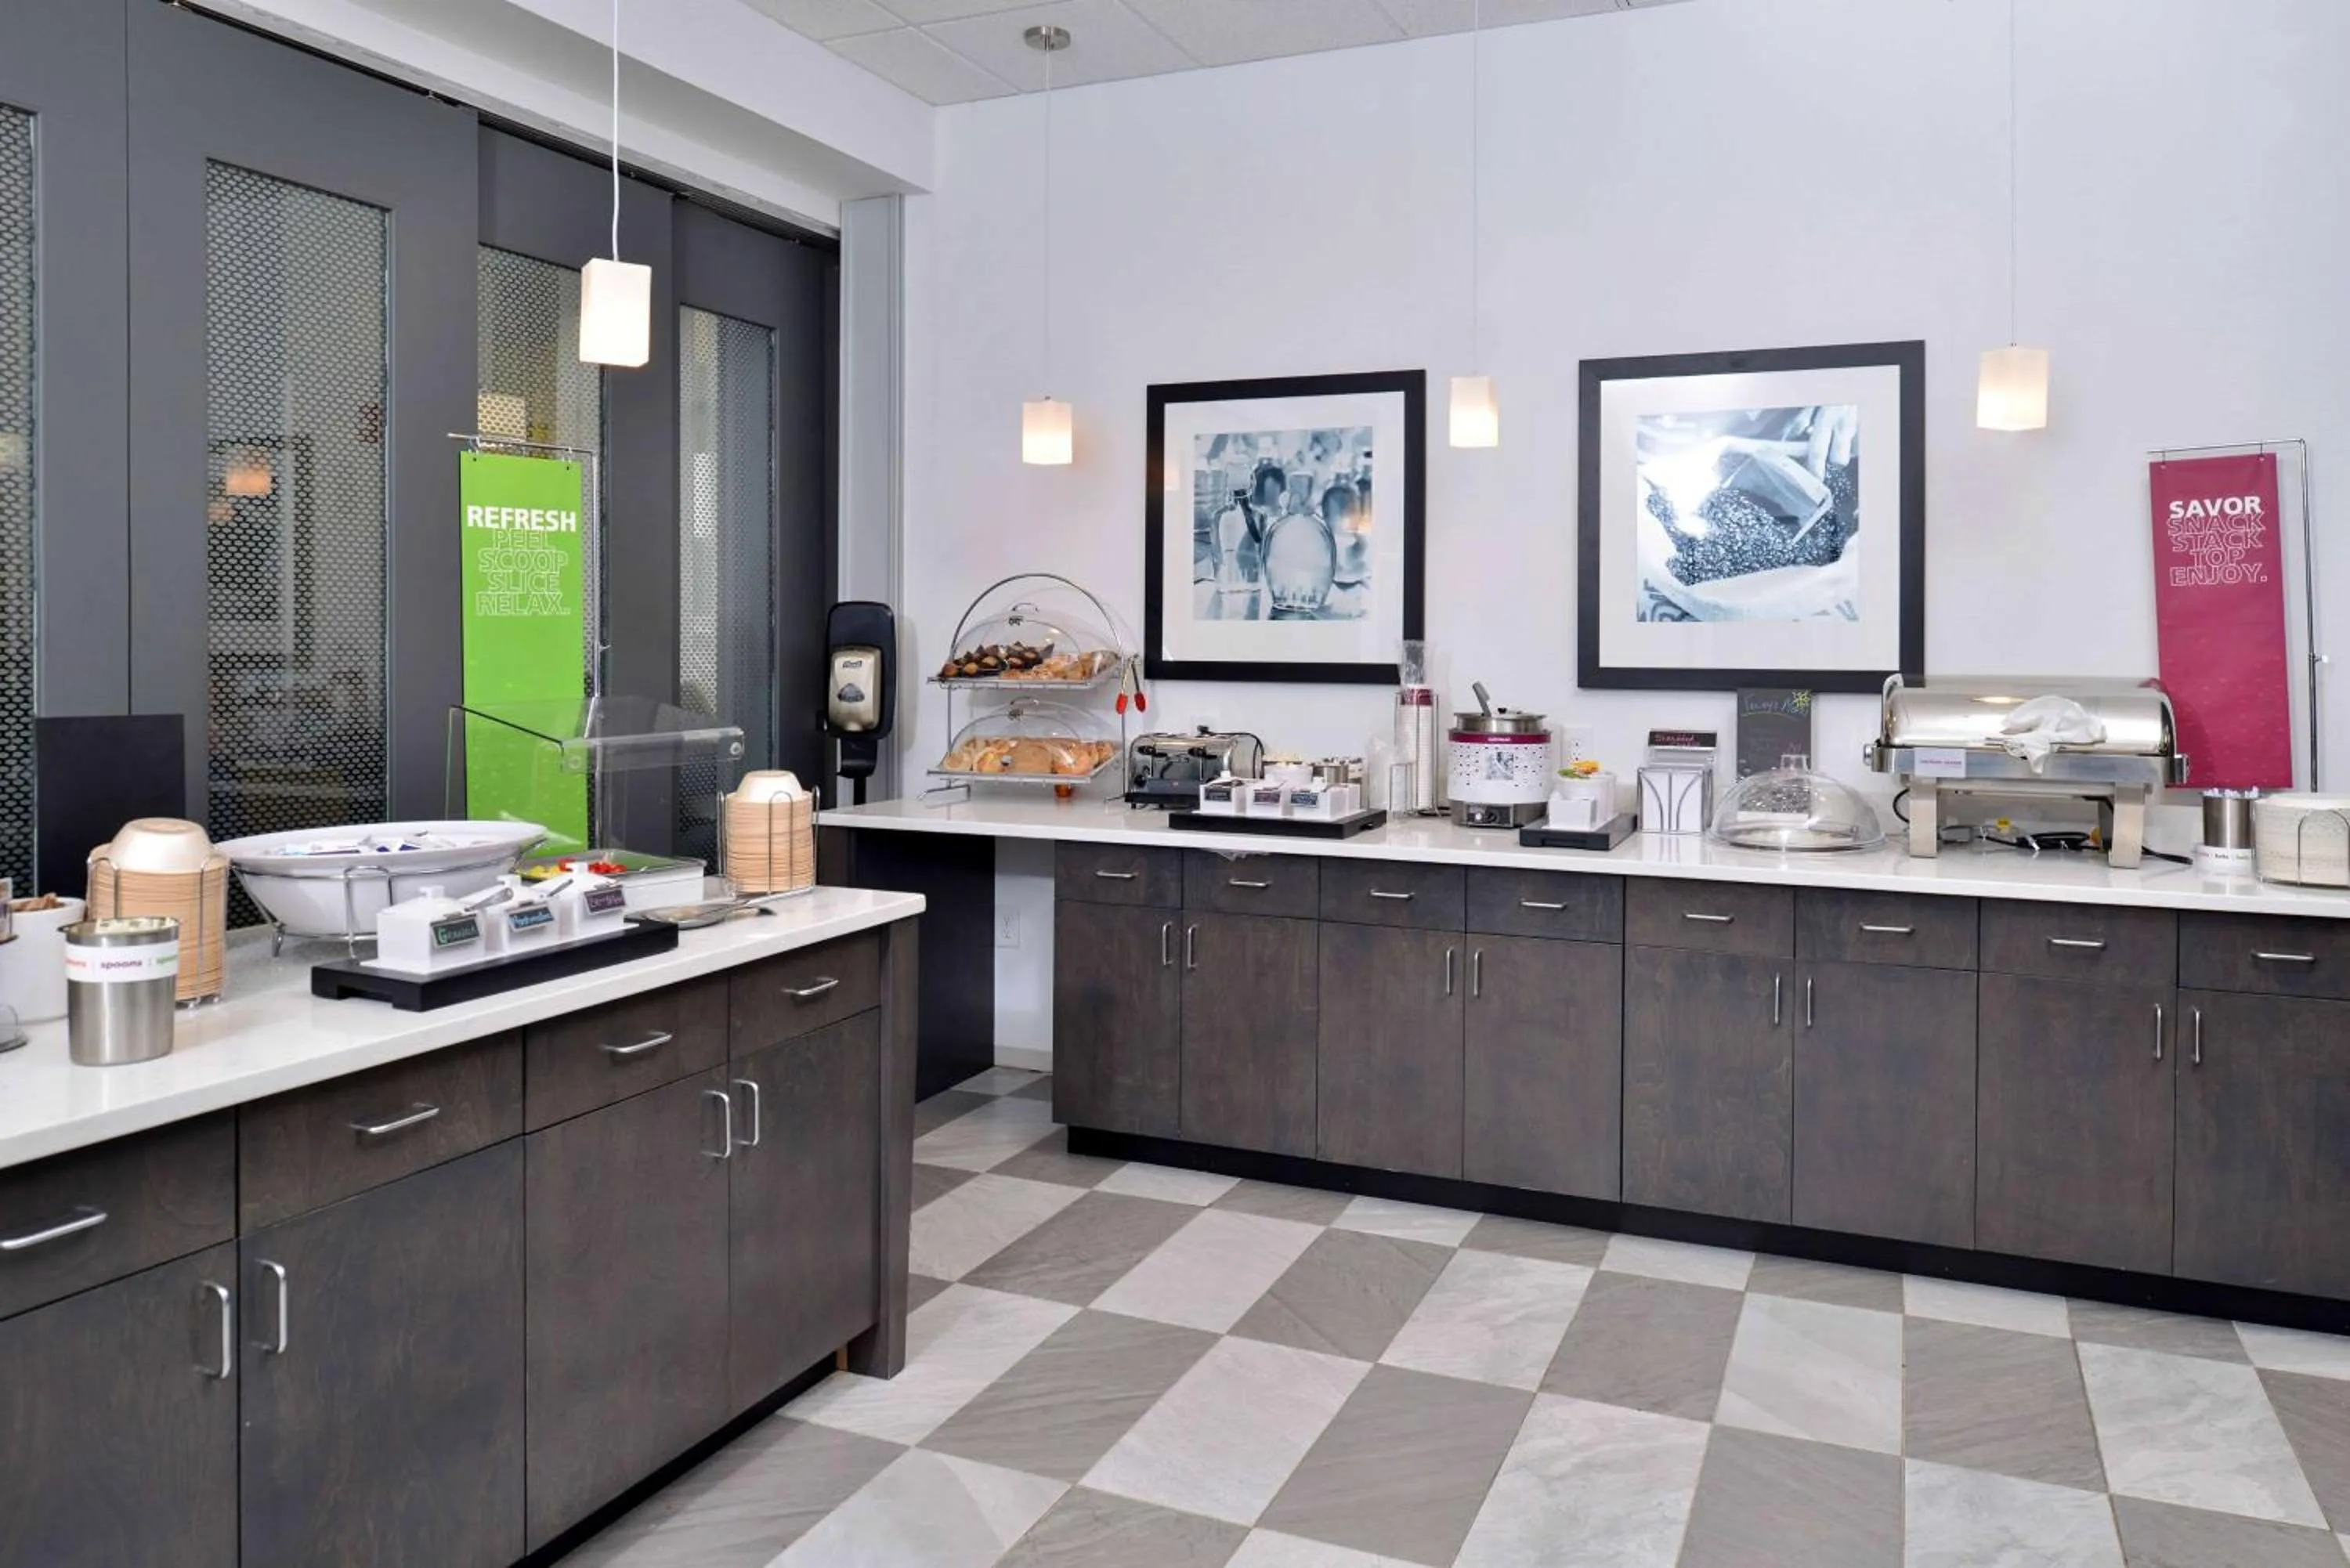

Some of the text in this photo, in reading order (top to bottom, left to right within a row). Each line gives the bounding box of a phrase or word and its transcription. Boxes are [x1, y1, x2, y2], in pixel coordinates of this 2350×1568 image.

[468, 506, 576, 531] REFRESH
[2168, 496, 2262, 518] SAVOR
[2166, 511, 2265, 537] SNACK
[494, 529, 555, 549] PEEL
[2171, 530, 2264, 553] STACK
[477, 547, 569, 574] SCOOP
[2189, 547, 2246, 568] TOP
[486, 570, 561, 594] SLICE
[2169, 562, 2269, 587] ENJOY.
[476, 591, 571, 615] RELAX.
